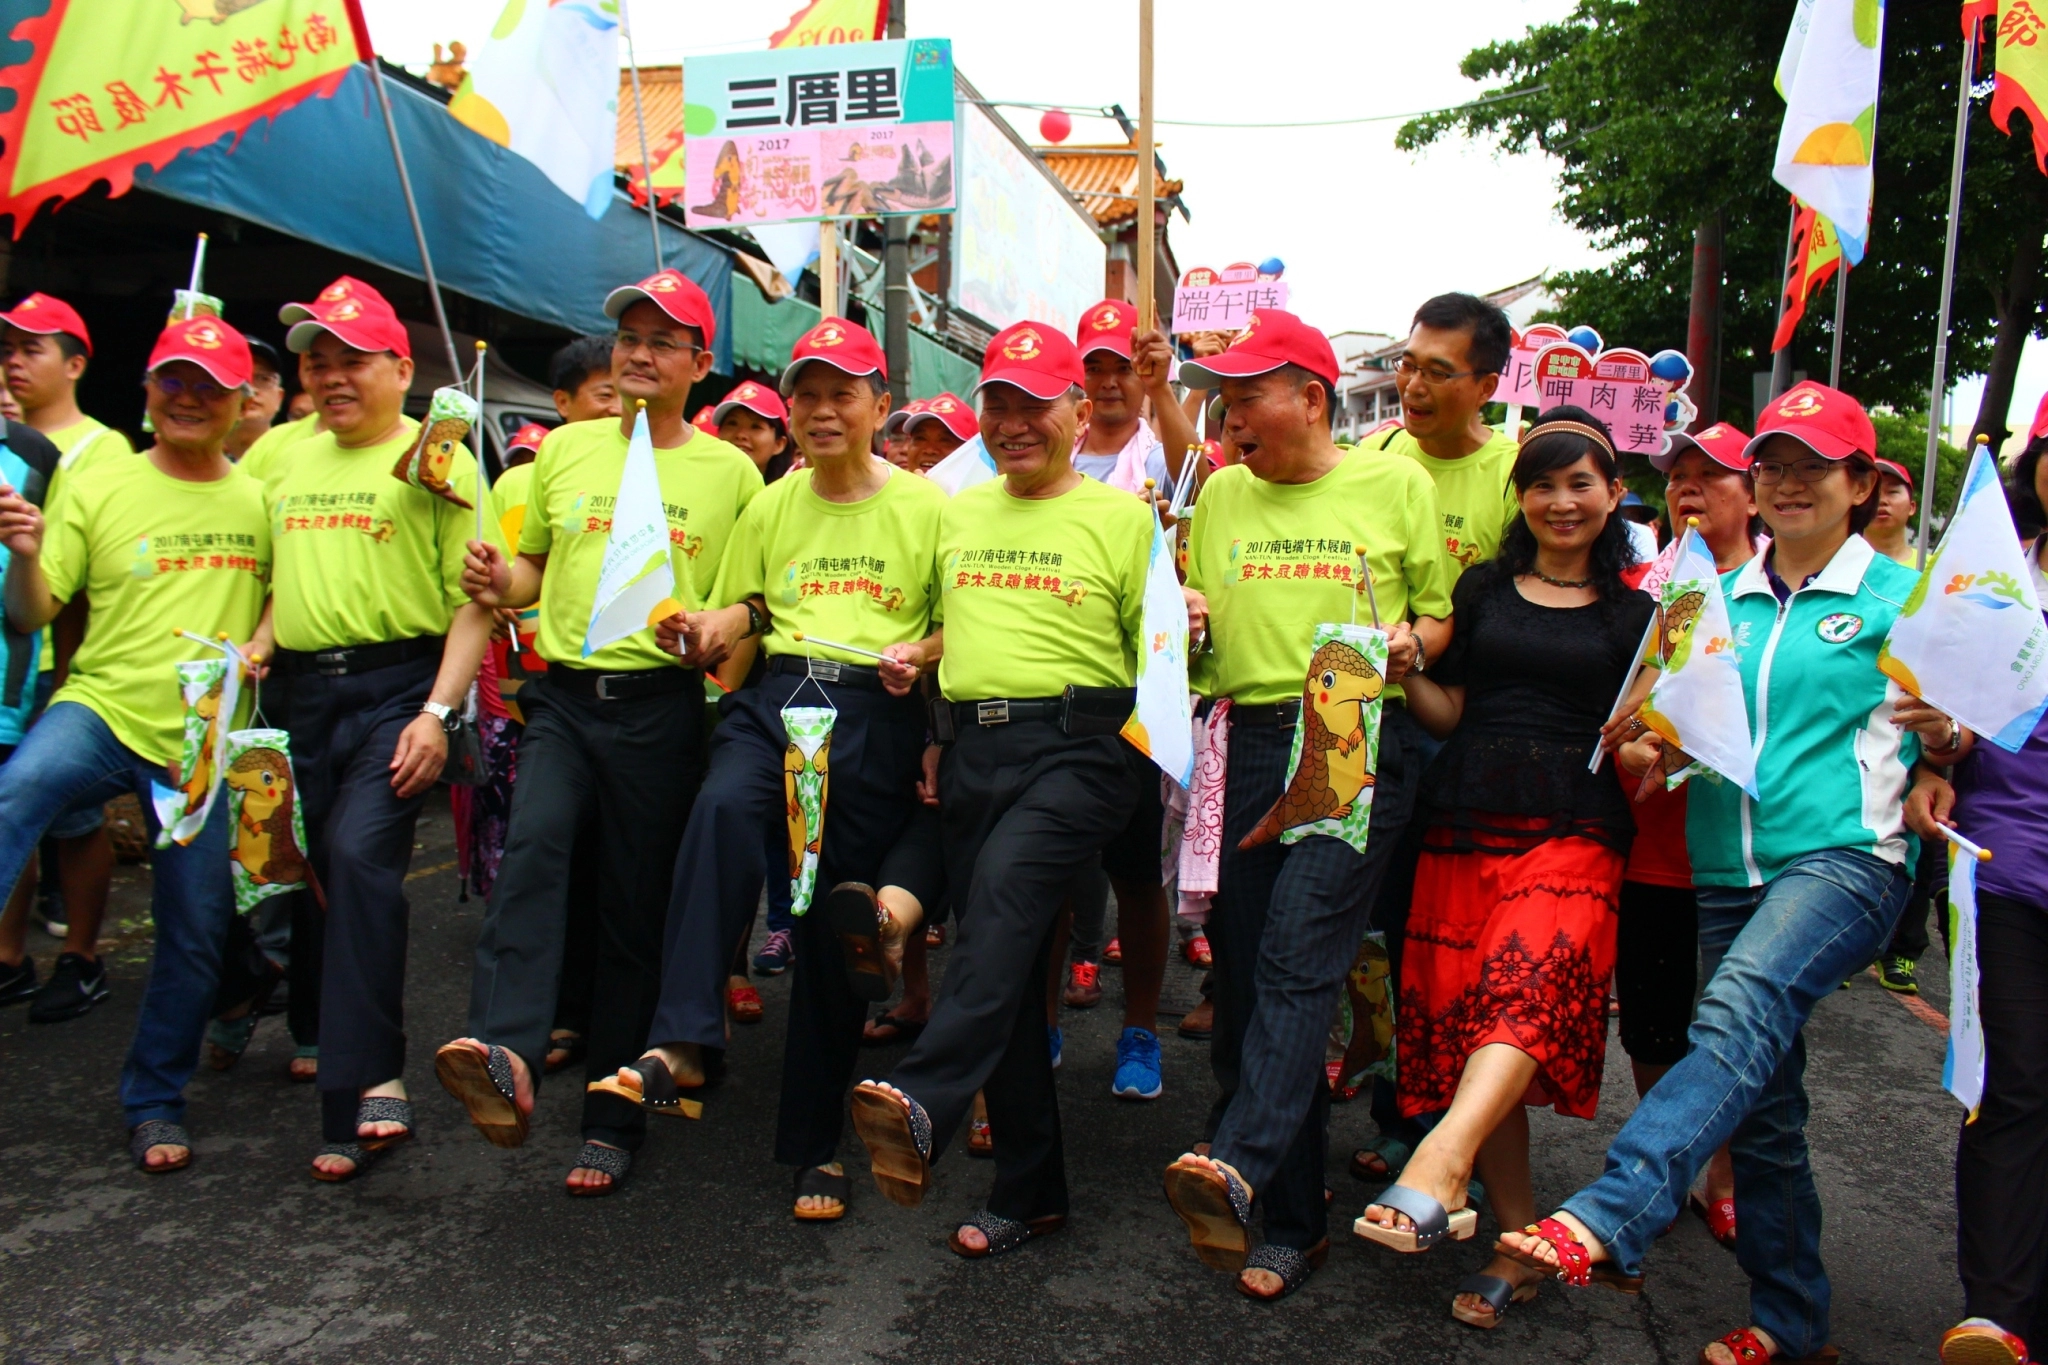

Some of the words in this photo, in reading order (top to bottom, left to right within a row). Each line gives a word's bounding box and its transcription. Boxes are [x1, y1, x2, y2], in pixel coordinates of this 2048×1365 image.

[870, 130, 894, 140] 2017
[758, 138, 790, 151] 2017
[1546, 379, 1662, 414] 呷肉粽
[590, 495, 616, 508] 2017
[1245, 539, 1352, 555] 2017南屯端午木屐節
[961, 549, 1063, 567] 2017南屯端午木屐節
